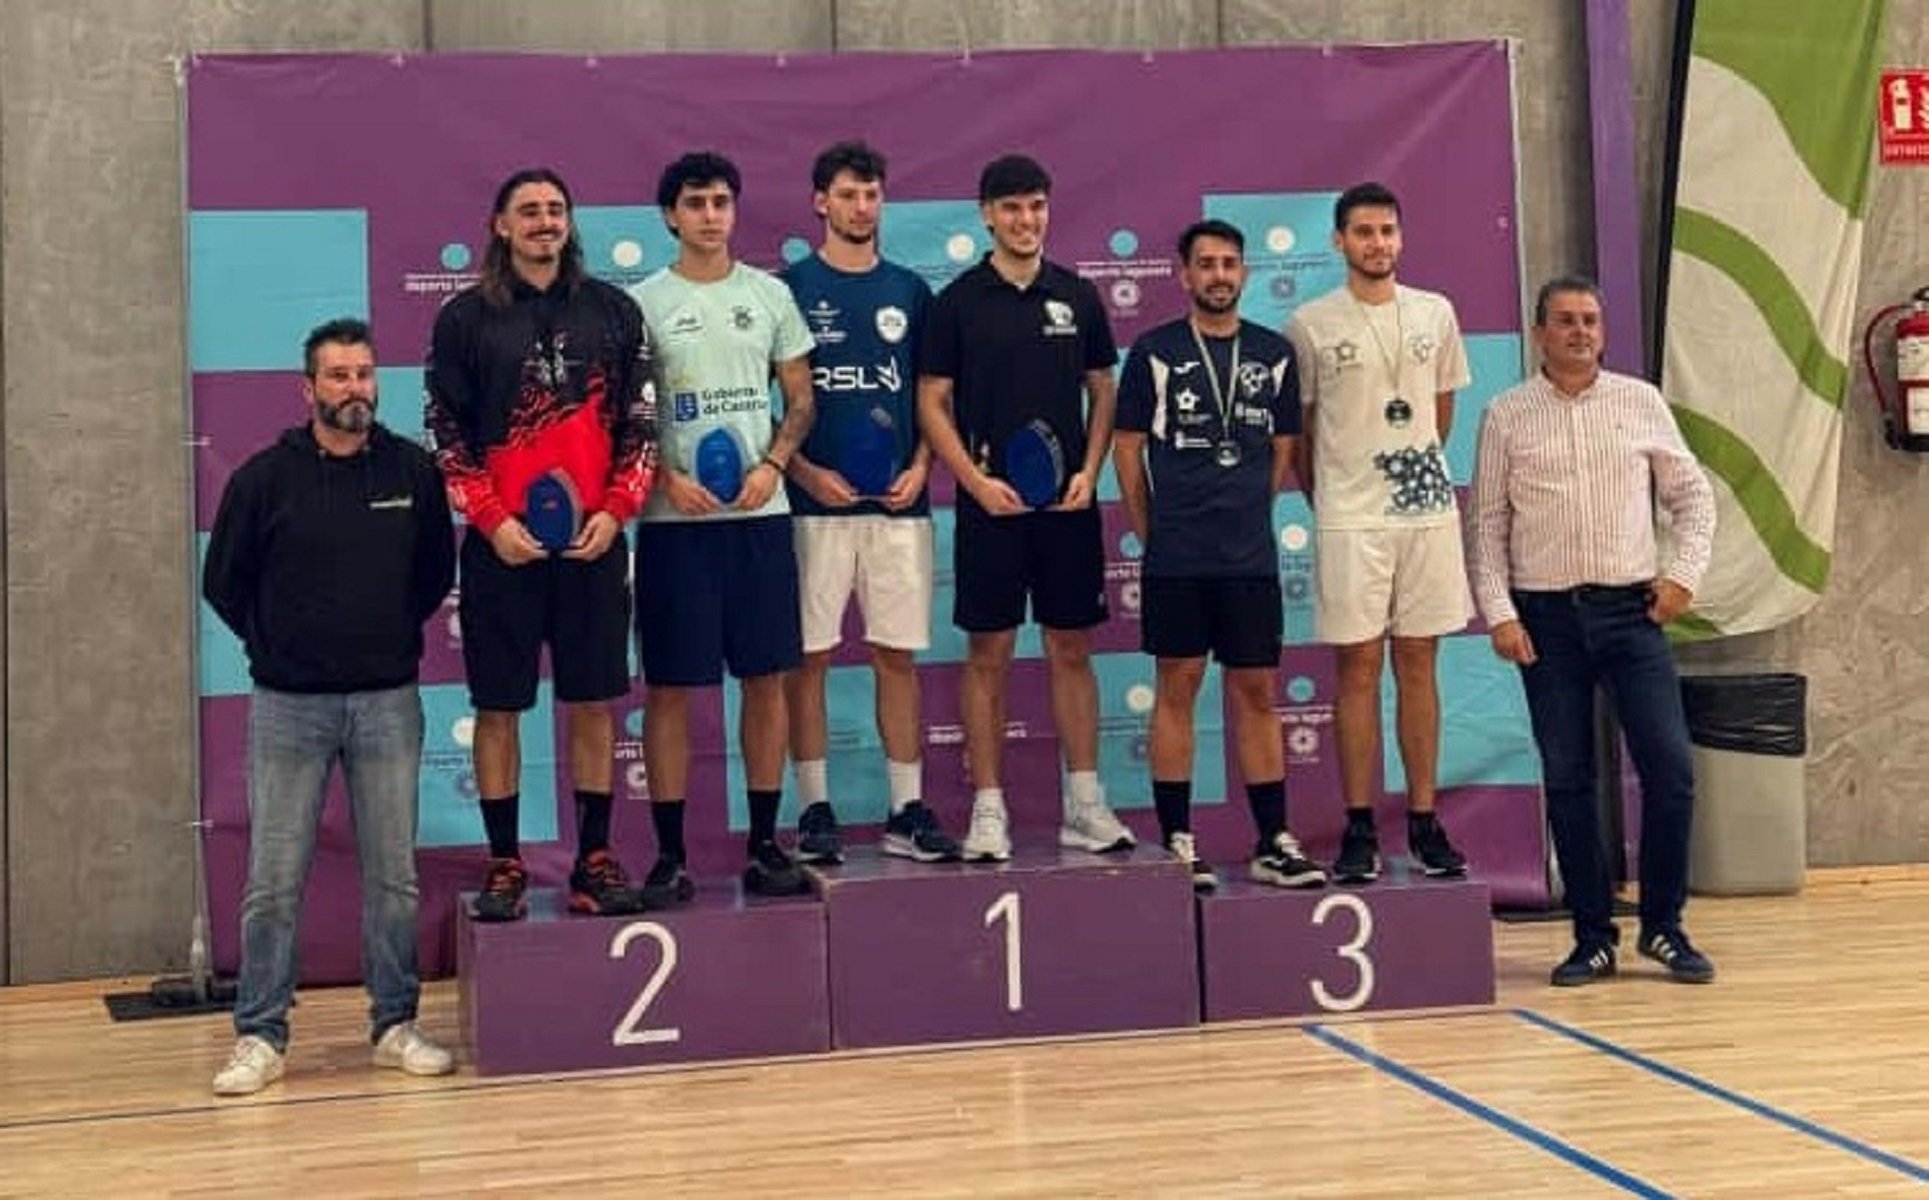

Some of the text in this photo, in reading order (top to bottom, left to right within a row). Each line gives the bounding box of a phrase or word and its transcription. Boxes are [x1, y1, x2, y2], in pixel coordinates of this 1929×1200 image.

[609, 921, 681, 1046] 2
[984, 892, 1023, 1011] 1
[1309, 893, 1376, 1012] 3
